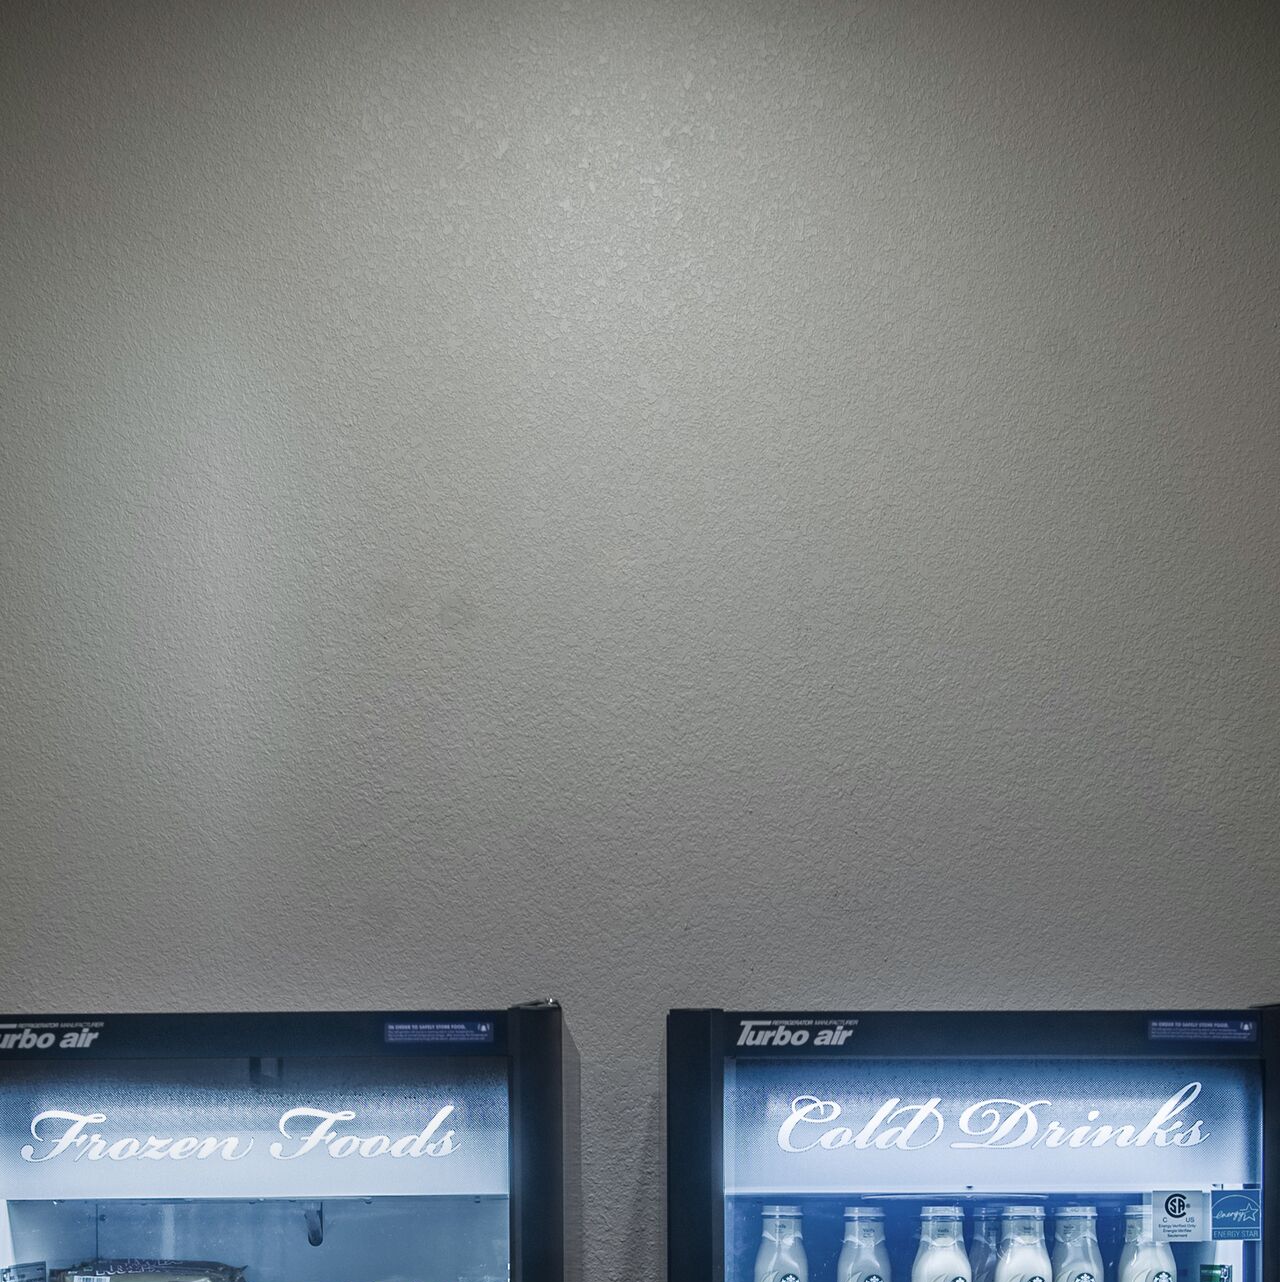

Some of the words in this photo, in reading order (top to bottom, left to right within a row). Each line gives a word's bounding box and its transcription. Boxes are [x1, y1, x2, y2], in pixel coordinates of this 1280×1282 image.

[59, 1027, 99, 1048] air
[736, 1020, 809, 1046] Turbo
[813, 1025, 853, 1046] air
[777, 1095, 945, 1153] Cold
[950, 1081, 1211, 1150] Drinks
[20, 1107, 255, 1163] Frozen
[269, 1104, 462, 1161] Foods
[1241, 1230, 1259, 1238] STAR
